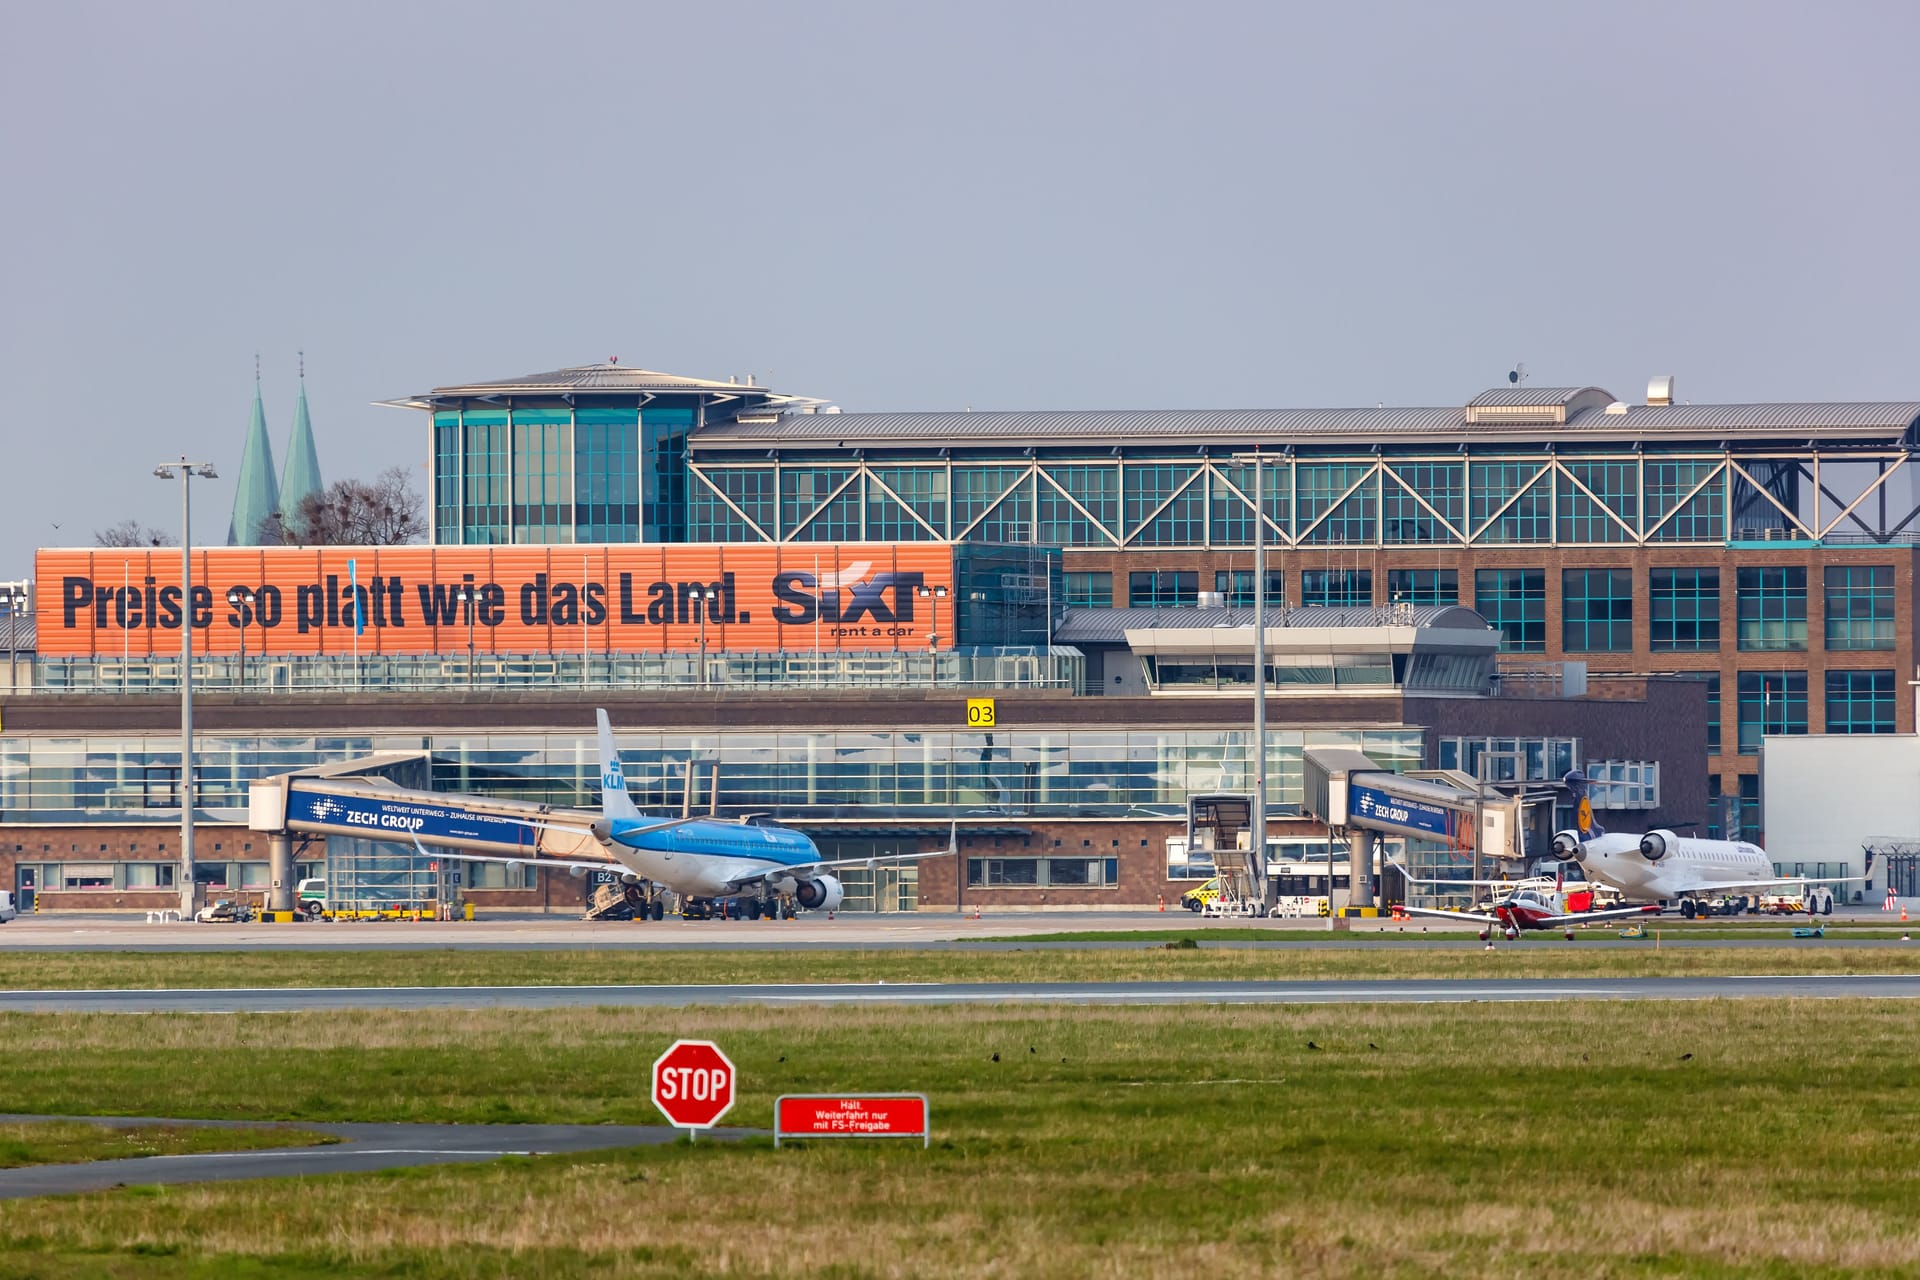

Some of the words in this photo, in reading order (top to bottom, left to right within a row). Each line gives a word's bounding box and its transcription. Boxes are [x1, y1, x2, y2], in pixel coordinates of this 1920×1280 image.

[63, 576, 213, 629] Preise
[226, 585, 281, 628] so
[297, 575, 405, 633] platt
[417, 574, 505, 626] wie
[520, 573, 606, 625] das
[620, 572, 750, 624] Land.
[831, 627, 867, 636] rent
[969, 706, 993, 722] 03
[603, 773, 625, 790] KLM
[346, 811, 378, 825] ZECH
[381, 814, 424, 830] GROUP
[382, 805, 410, 814] WELTWEIT
[410, 808, 445, 817] UNTERWEGS
[450, 812, 475, 820] ZUHAUSE
[1375, 804, 1389, 818] ZECH
[1390, 807, 1408, 822] GROUP
[597, 872, 612, 882] B2
[661, 1067, 726, 1102] STOP
[816, 1110, 869, 1120] Weiterfahrt
[872, 1112, 888, 1120] nur
[813, 1121, 828, 1129] mit
[832, 1121, 890, 1132] FS-Freigabe
